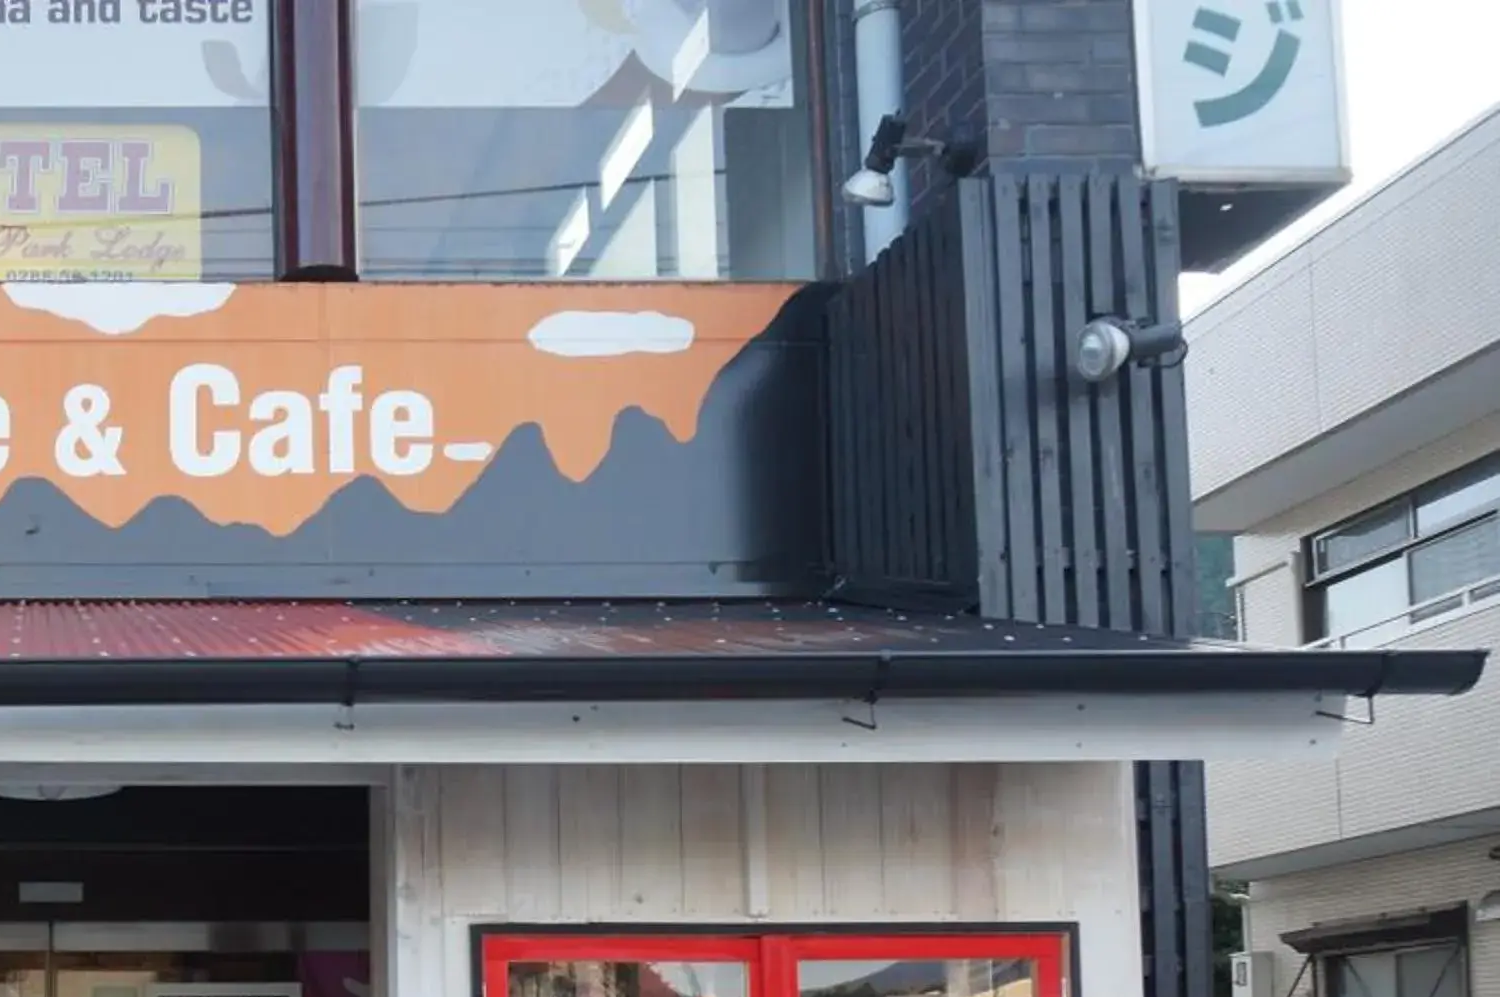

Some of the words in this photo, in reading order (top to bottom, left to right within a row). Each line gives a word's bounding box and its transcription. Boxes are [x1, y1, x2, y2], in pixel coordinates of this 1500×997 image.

[48, 0, 120, 24] and
[139, 0, 253, 24] taste
[88, 225, 187, 271] Lodge
[54, 383, 127, 476] &
[169, 362, 436, 477] Cafe
